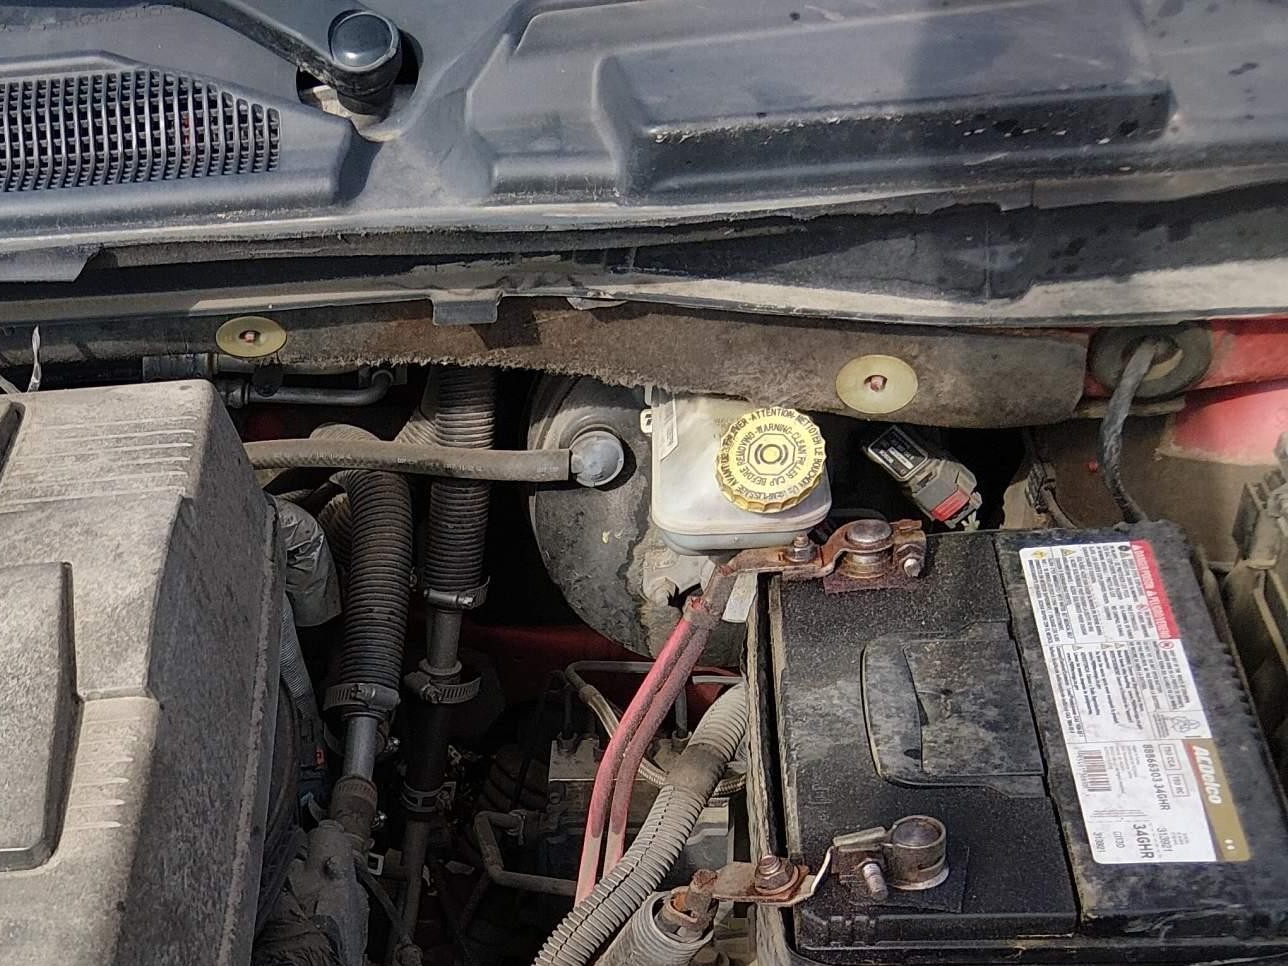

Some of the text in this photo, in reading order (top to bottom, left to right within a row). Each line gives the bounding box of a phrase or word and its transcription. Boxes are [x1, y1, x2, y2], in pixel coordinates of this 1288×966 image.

[1192, 745, 1222, 804] ACDelco
[1154, 783, 1171, 810] 34GHR
[1132, 823, 1155, 859] 34GHR
